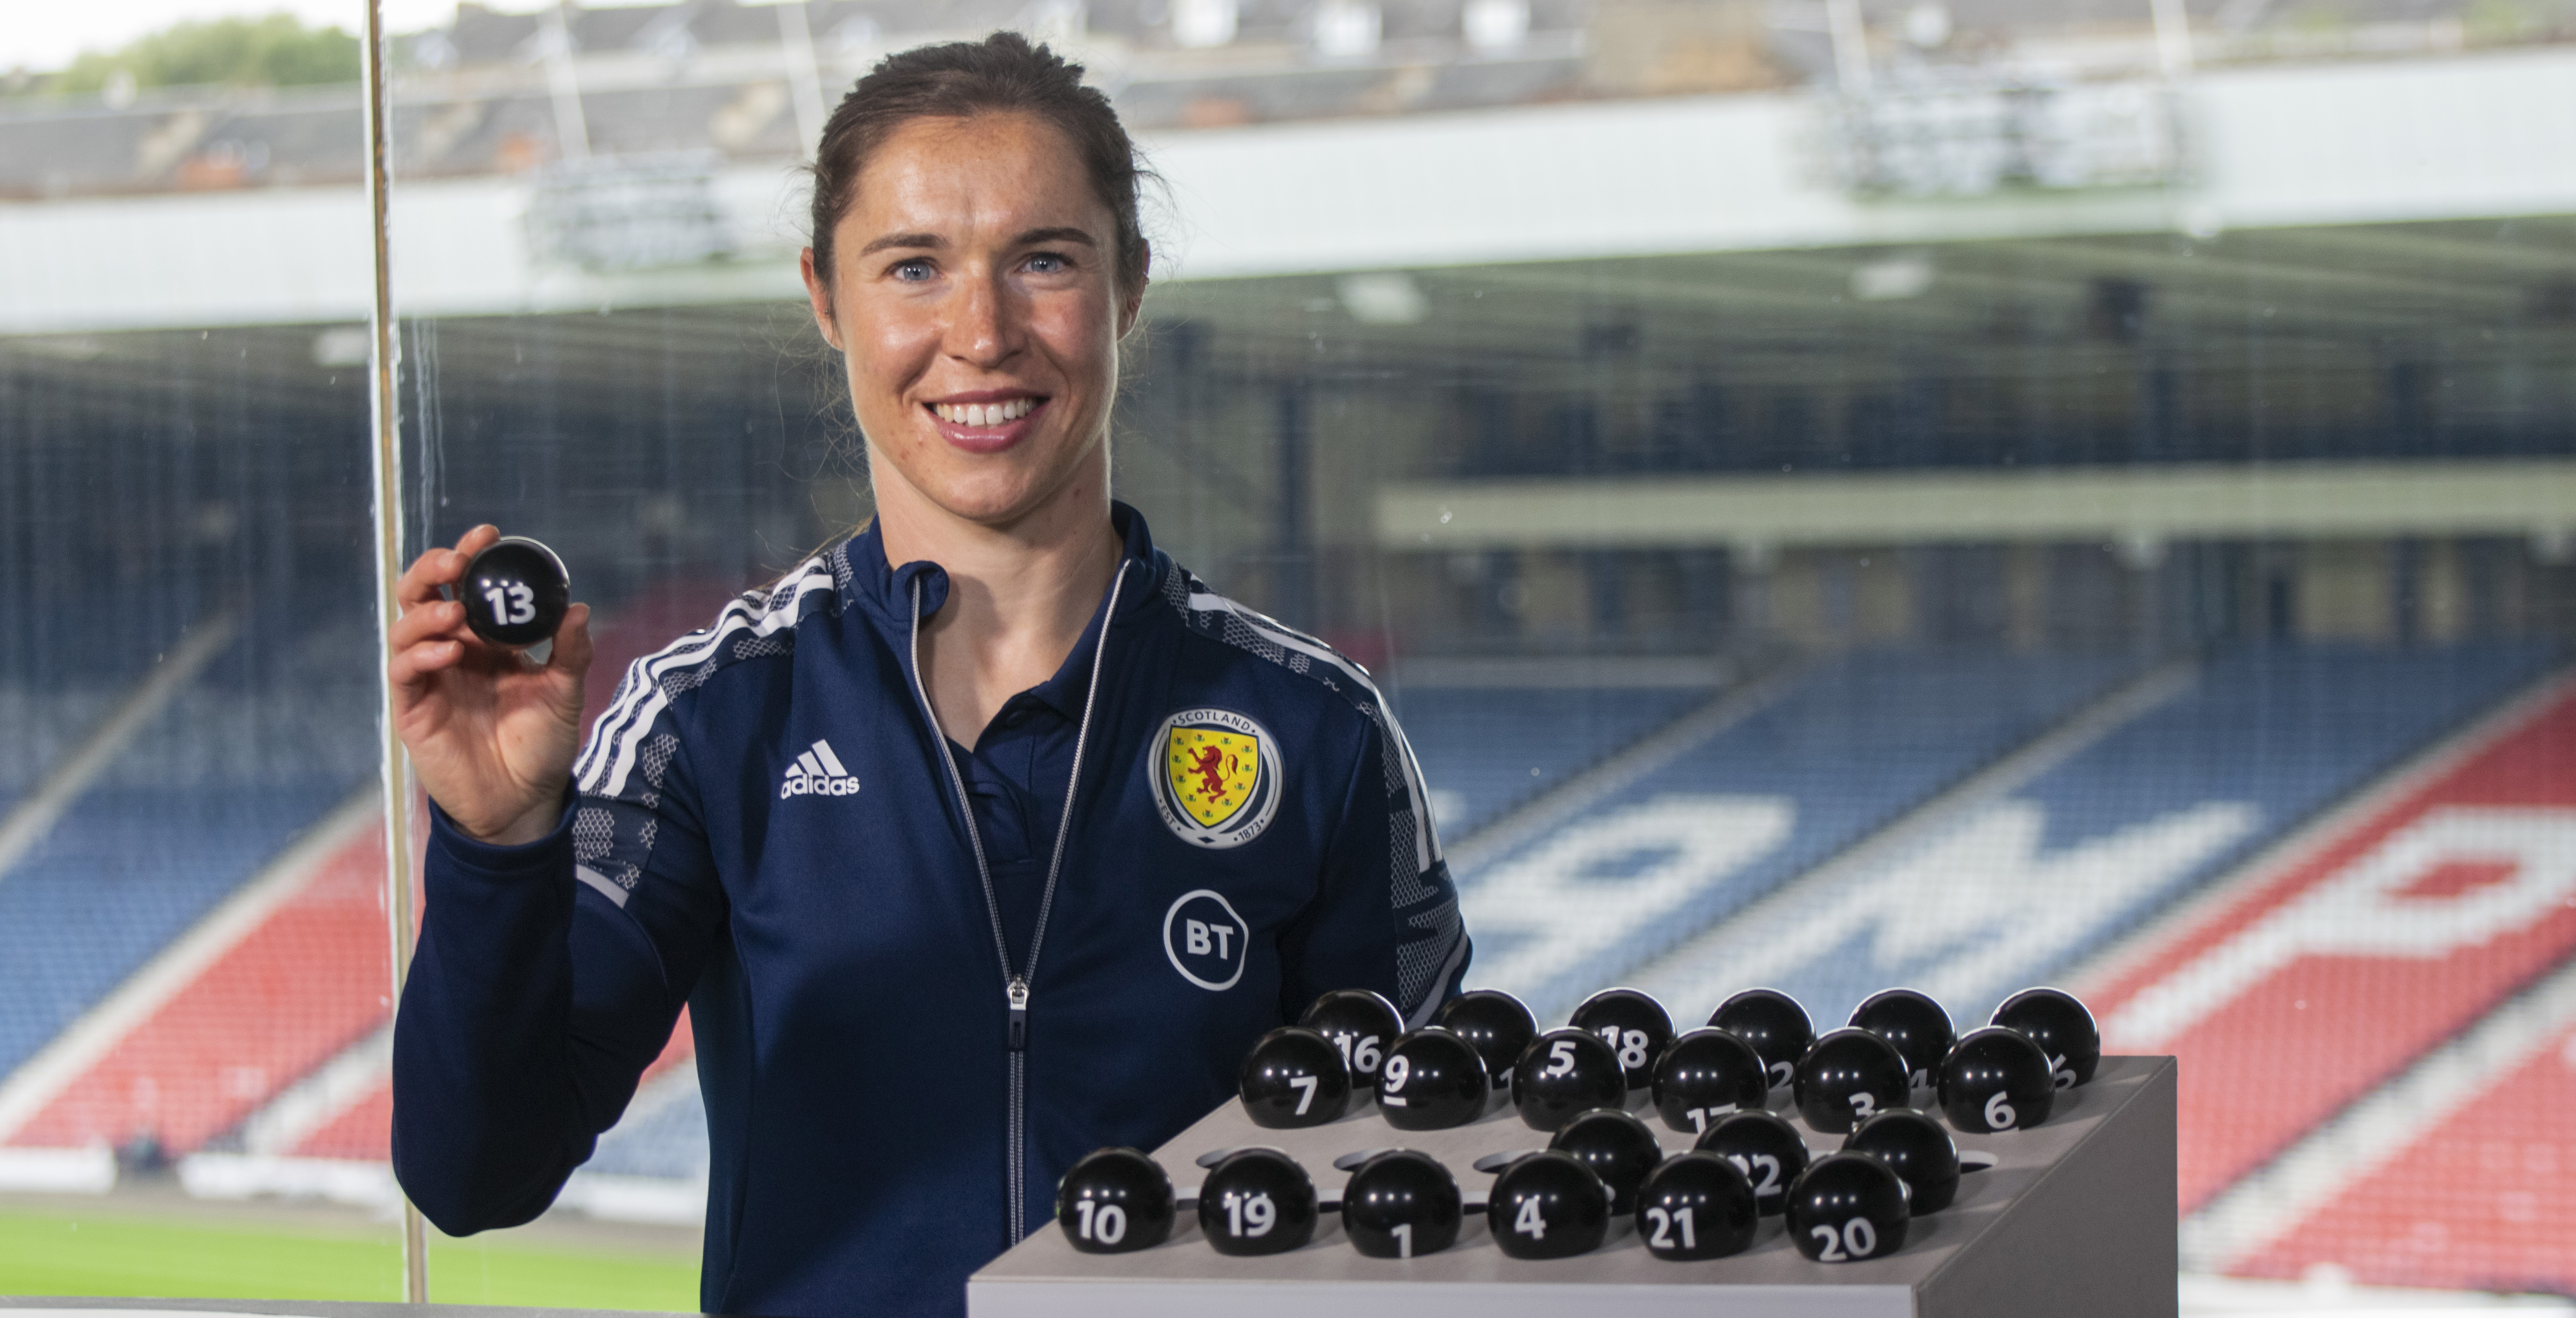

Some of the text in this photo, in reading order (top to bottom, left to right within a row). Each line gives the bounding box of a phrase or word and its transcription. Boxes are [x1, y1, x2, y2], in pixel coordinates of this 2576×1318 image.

[484, 584, 537, 626] 13
[1178, 710, 1250, 731] SCOTLAND
[781, 773, 860, 800] adidas
[1160, 805, 1176, 825] EST
[1237, 821, 1261, 841] 1873
[1186, 918, 1234, 961] BT
[1334, 1034, 1382, 1073] 16
[1546, 1041, 1577, 1076] 5
[1601, 1025, 1649, 1069] 18
[1385, 1054, 1410, 1093] 9
[1290, 1075, 1318, 1116] 7
[1984, 1090, 2016, 1129] 6
[1076, 1200, 1127, 1245] 10
[1223, 1195, 1276, 1238] 19
[1515, 1197, 1546, 1239] 4
[1646, 1206, 1696, 1249] 21
[1391, 1224, 1412, 1258] 1
[1810, 1216, 1877, 1261] 20
